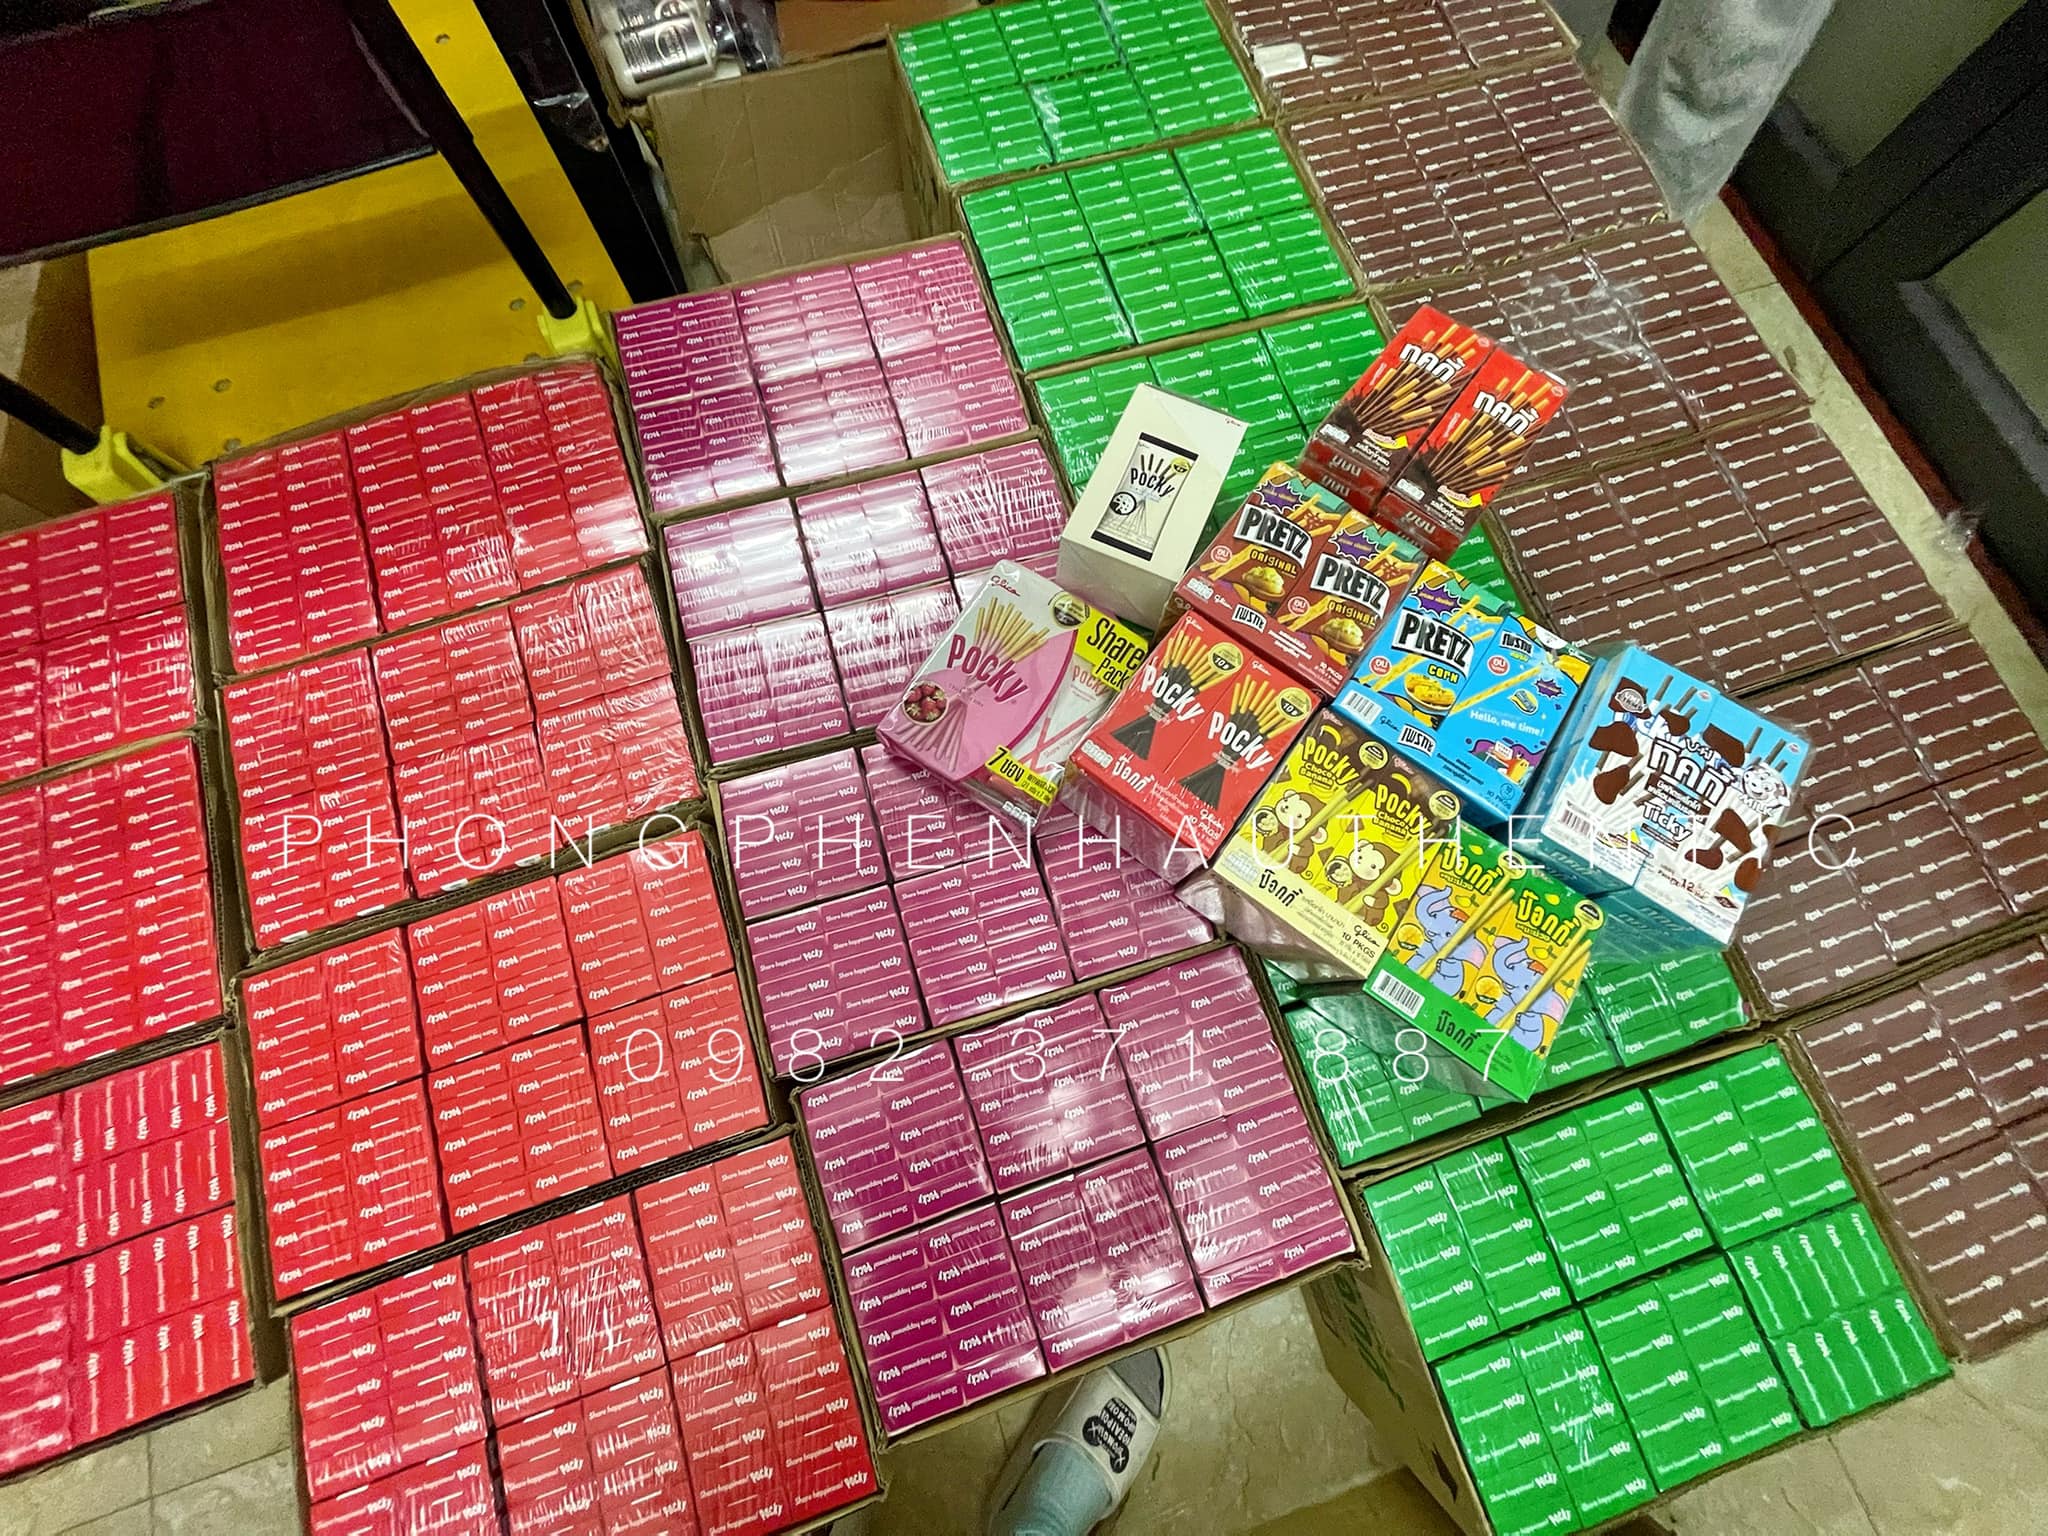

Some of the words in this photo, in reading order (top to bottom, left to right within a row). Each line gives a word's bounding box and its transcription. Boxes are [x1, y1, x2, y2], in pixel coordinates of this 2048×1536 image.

[1241, 507, 1311, 559] PRETZ
[1317, 558, 1390, 611] PRETZ
[1086, 617, 1147, 672] Share
[1399, 614, 1474, 667] PRETZ
[1094, 656, 1131, 692] Pack
[1470, 709, 1500, 727] Hello,
[1501, 718, 1517, 729] me
[1517, 720, 1545, 738] time!
[988, 747, 1008, 766] 7
[1342, 931, 1352, 941] 10
[1352, 939, 1376, 959] PKGS
[1353, 925, 1381, 948] Glico
